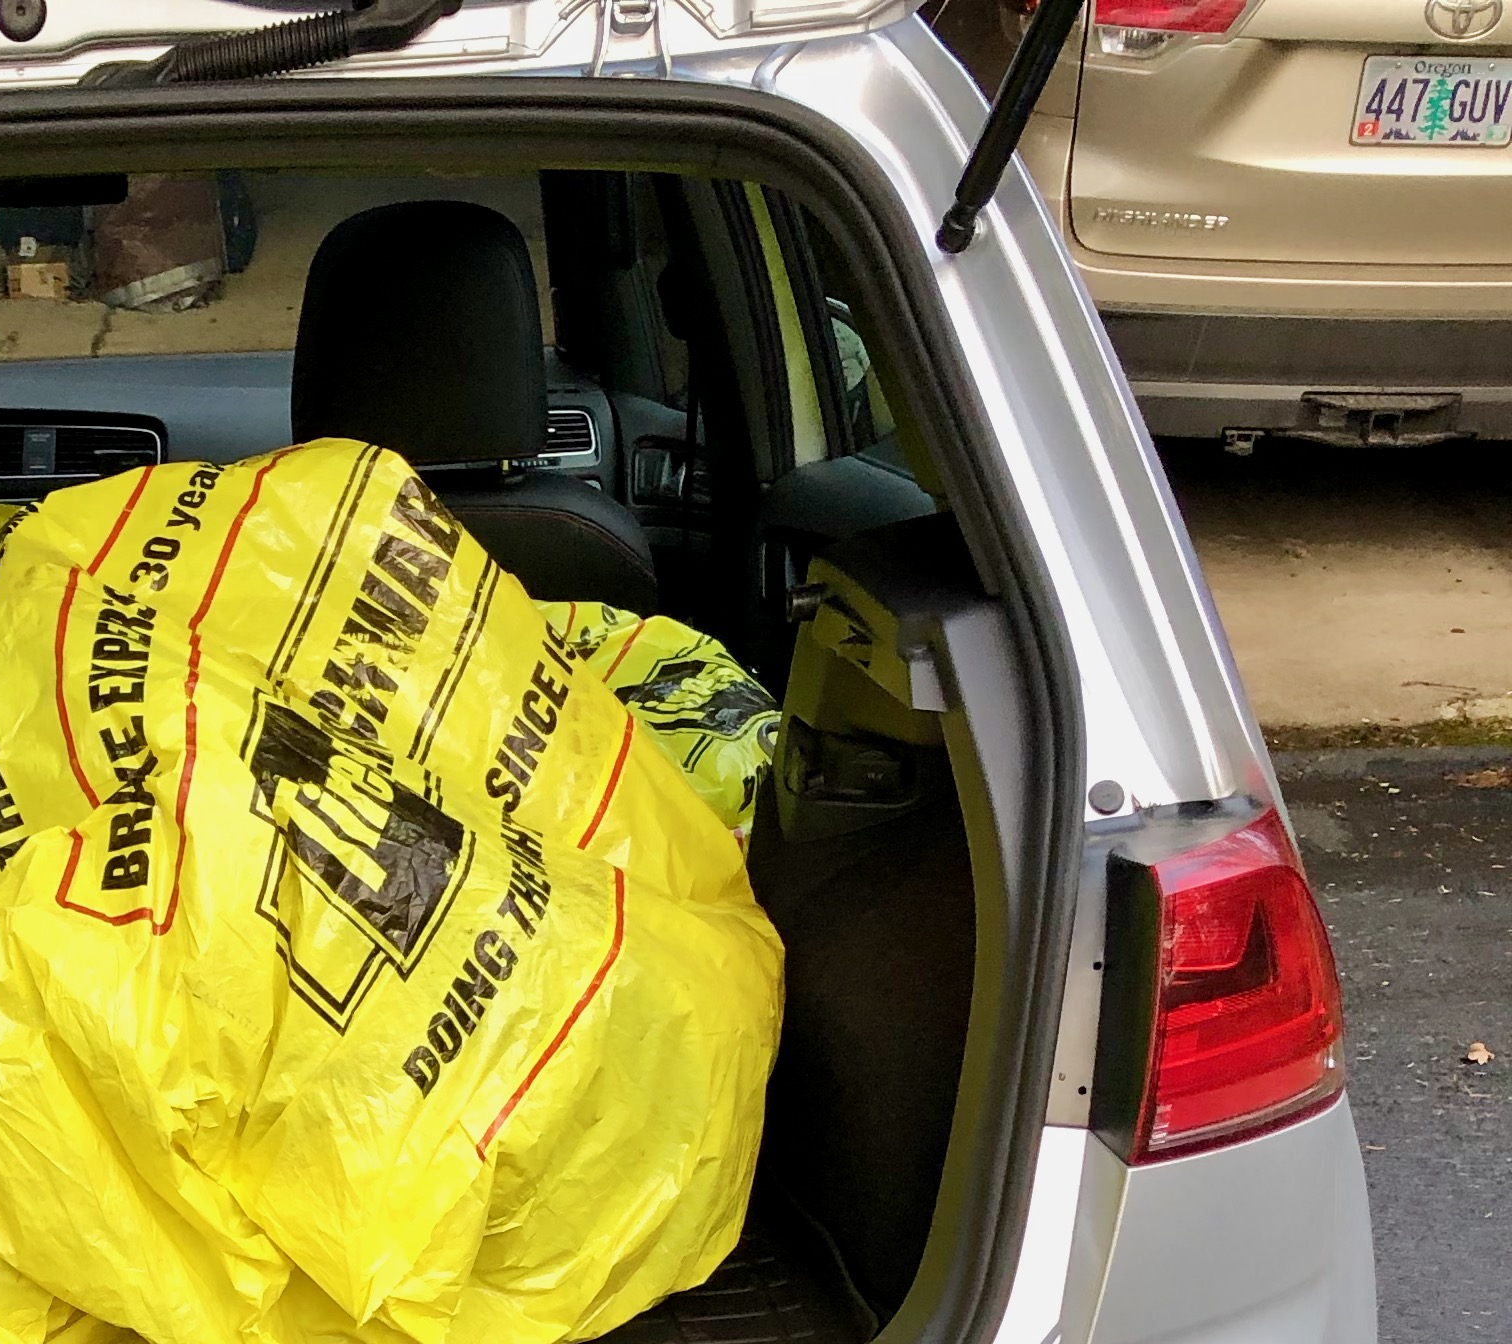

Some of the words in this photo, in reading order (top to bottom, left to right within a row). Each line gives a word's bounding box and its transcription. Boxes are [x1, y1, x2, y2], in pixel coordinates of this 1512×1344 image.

[1365, 78, 1431, 123] 447
[1449, 78, 1512, 124] GUV
[1414, 61, 1472, 78] Oregon
[1092, 207, 1229, 232] HIGHLANDER
[98, 714, 159, 891] BRAKE
[129, 536, 181, 592] 30
[485, 659, 571, 814] SINCE
[273, 735, 395, 894] Tire
[496, 858, 552, 940] THE
[402, 929, 519, 1100] DOING
